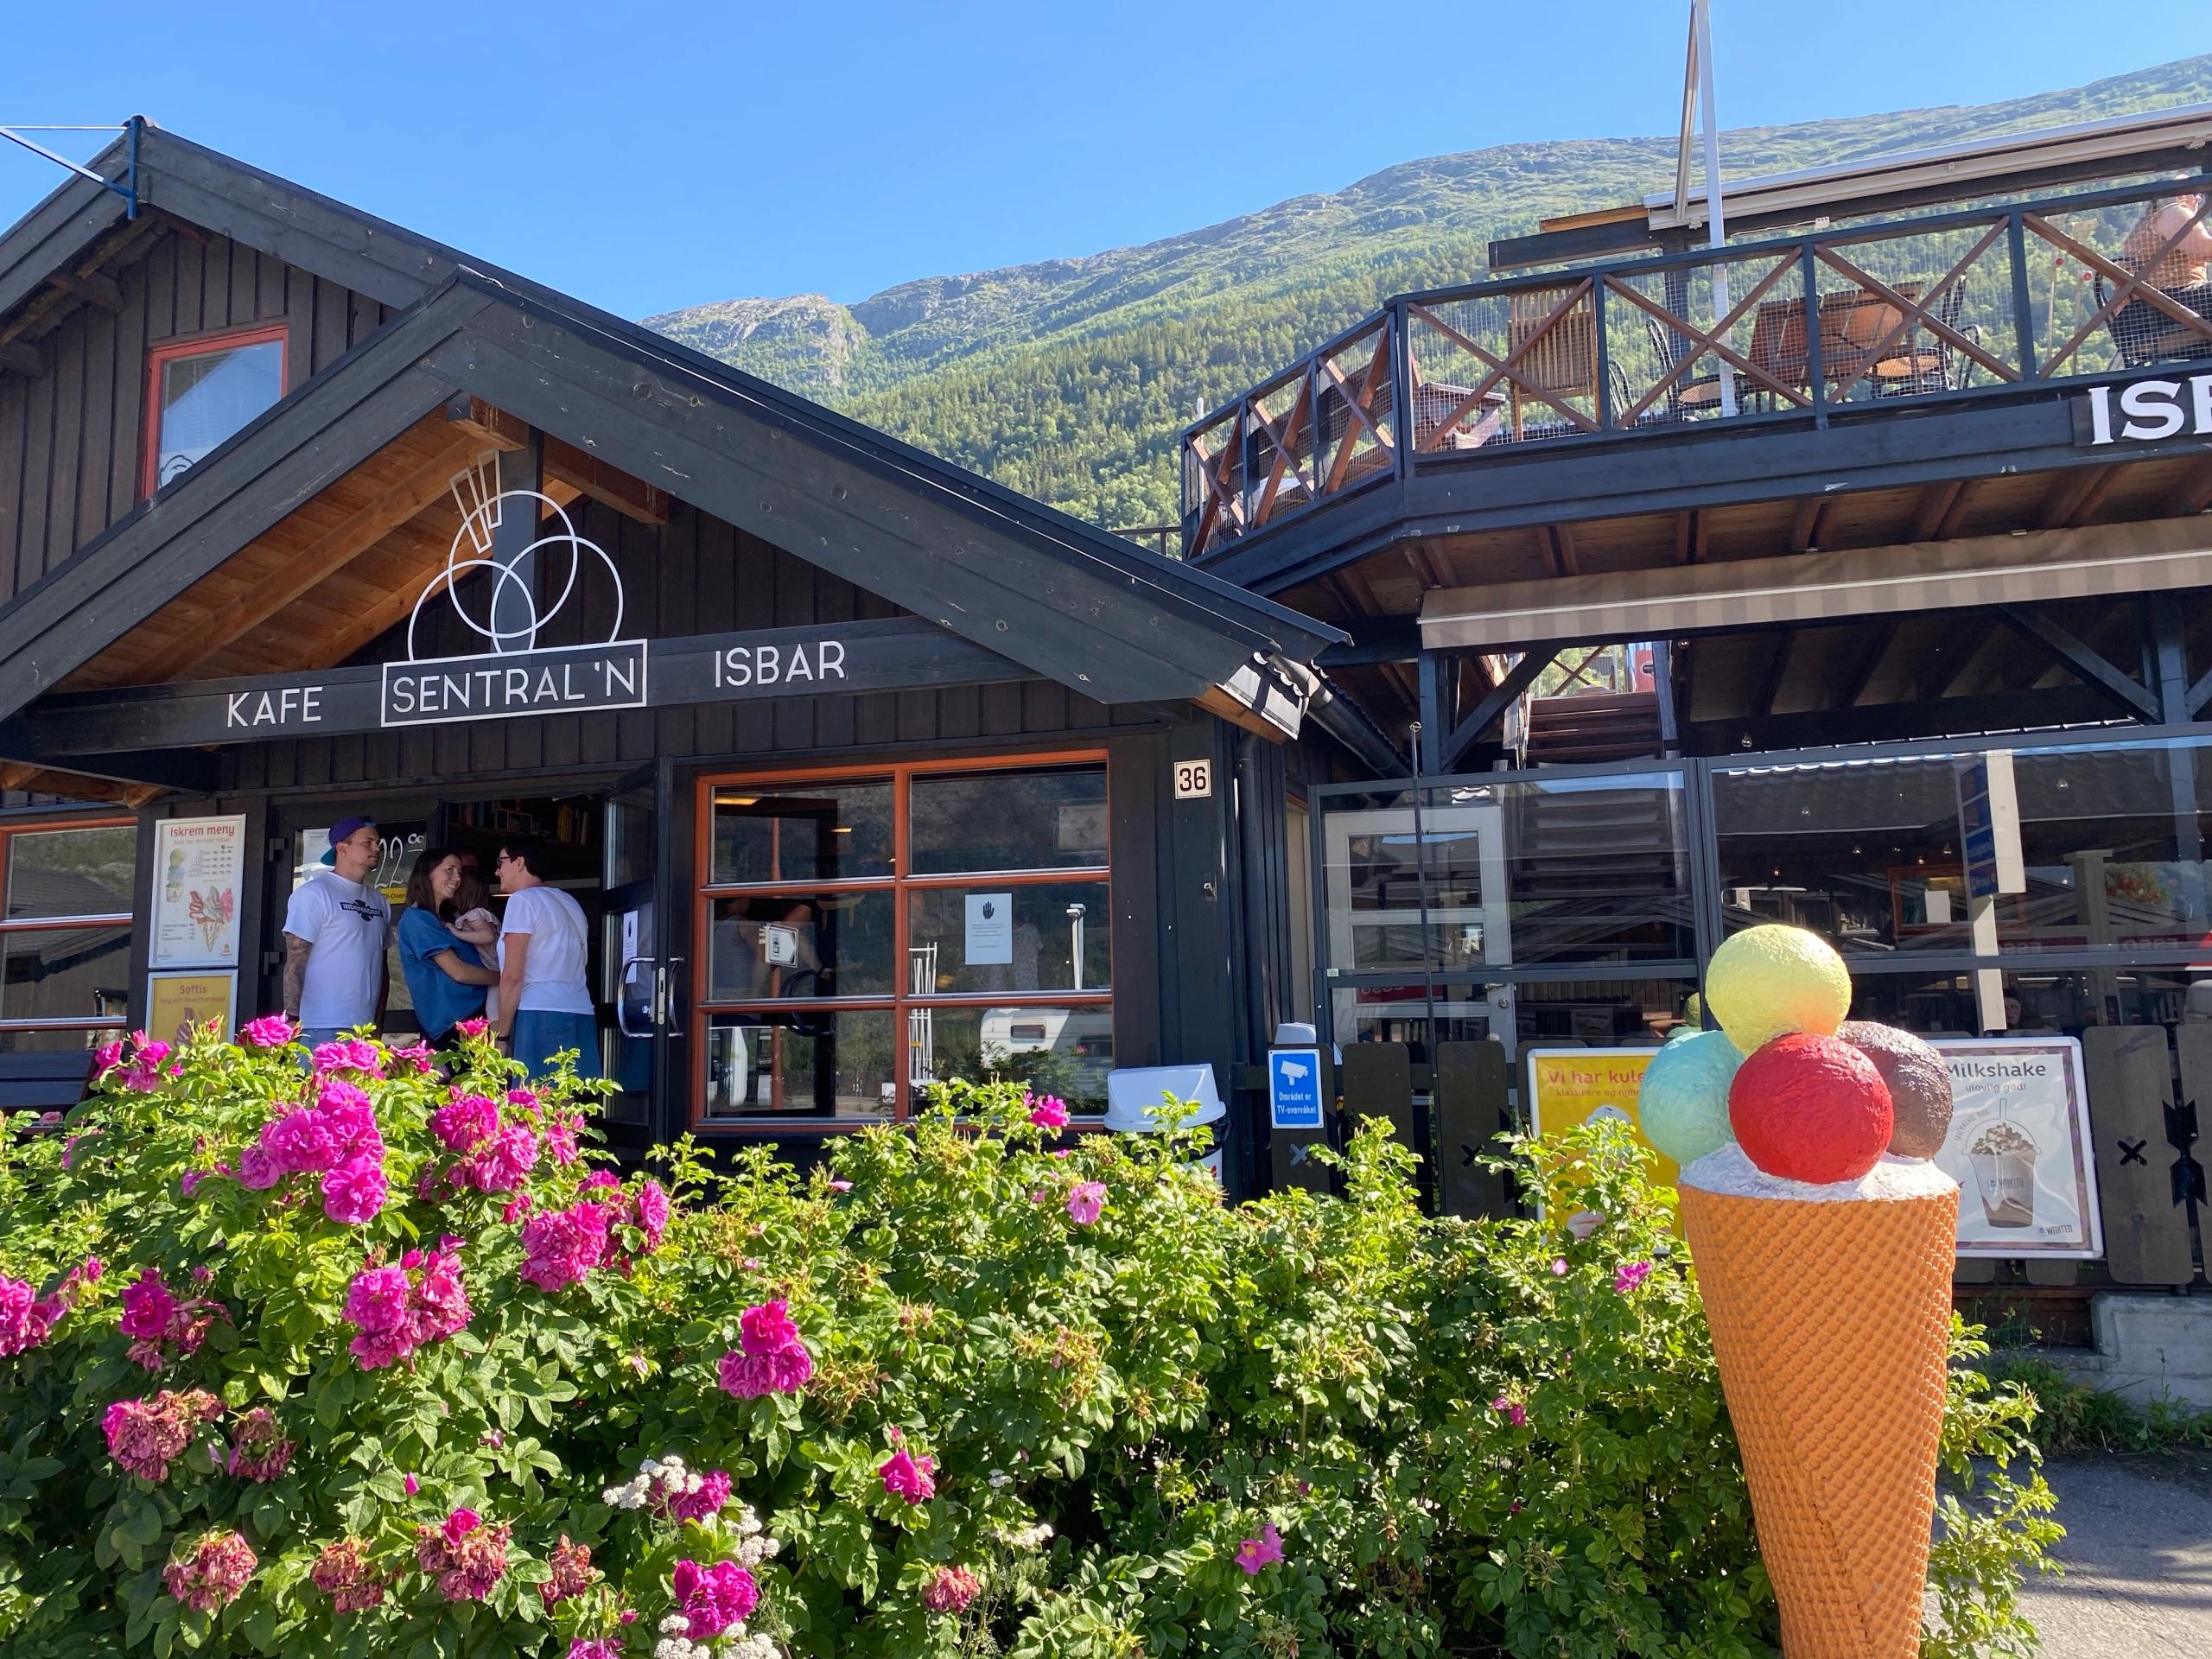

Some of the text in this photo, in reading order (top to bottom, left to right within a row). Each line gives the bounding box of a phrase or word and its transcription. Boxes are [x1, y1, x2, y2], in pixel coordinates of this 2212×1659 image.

[715, 640, 848, 688] ISBAR
[226, 686, 323, 728] KAFE
[1179, 766, 1206, 791] 36
[170, 825, 234, 837] Iskrem meny
[180, 984, 207, 995] Softis
[1947, 1062, 2046, 1077] Milkshake
[1548, 1070, 1645, 1084] Vi har kule
[1279, 1091, 1304, 1101] Området
[1277, 1104, 1316, 1115] TV-overvåket
[2046, 1224, 2073, 1235] WANTED
